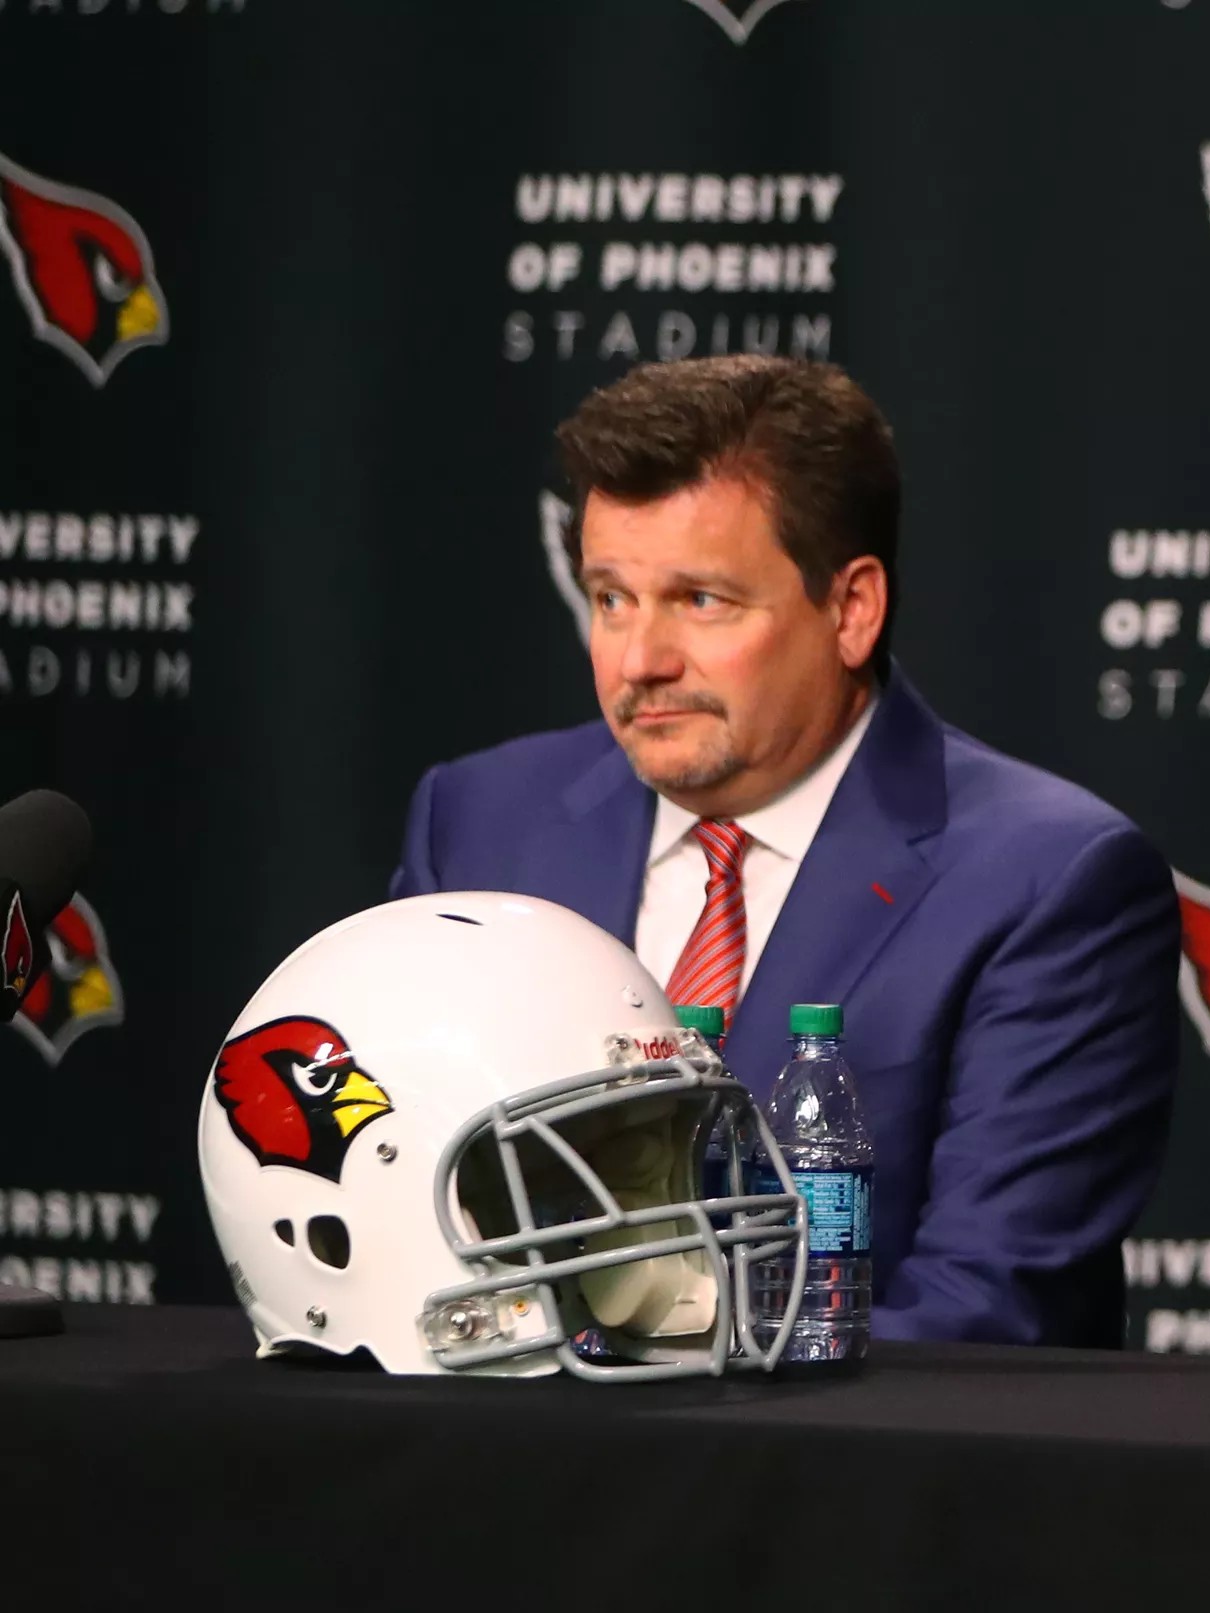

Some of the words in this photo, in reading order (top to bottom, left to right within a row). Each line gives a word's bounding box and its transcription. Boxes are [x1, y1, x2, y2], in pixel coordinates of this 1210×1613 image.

[516, 172, 843, 223] UNIVERSITY
[508, 242, 582, 292] OF
[601, 242, 836, 292] PHOENIX
[503, 310, 831, 362] STADIUM
[0, 578, 195, 631] HOENIX
[1100, 599, 1183, 650] OF
[0, 1188, 161, 1241] RSITY
